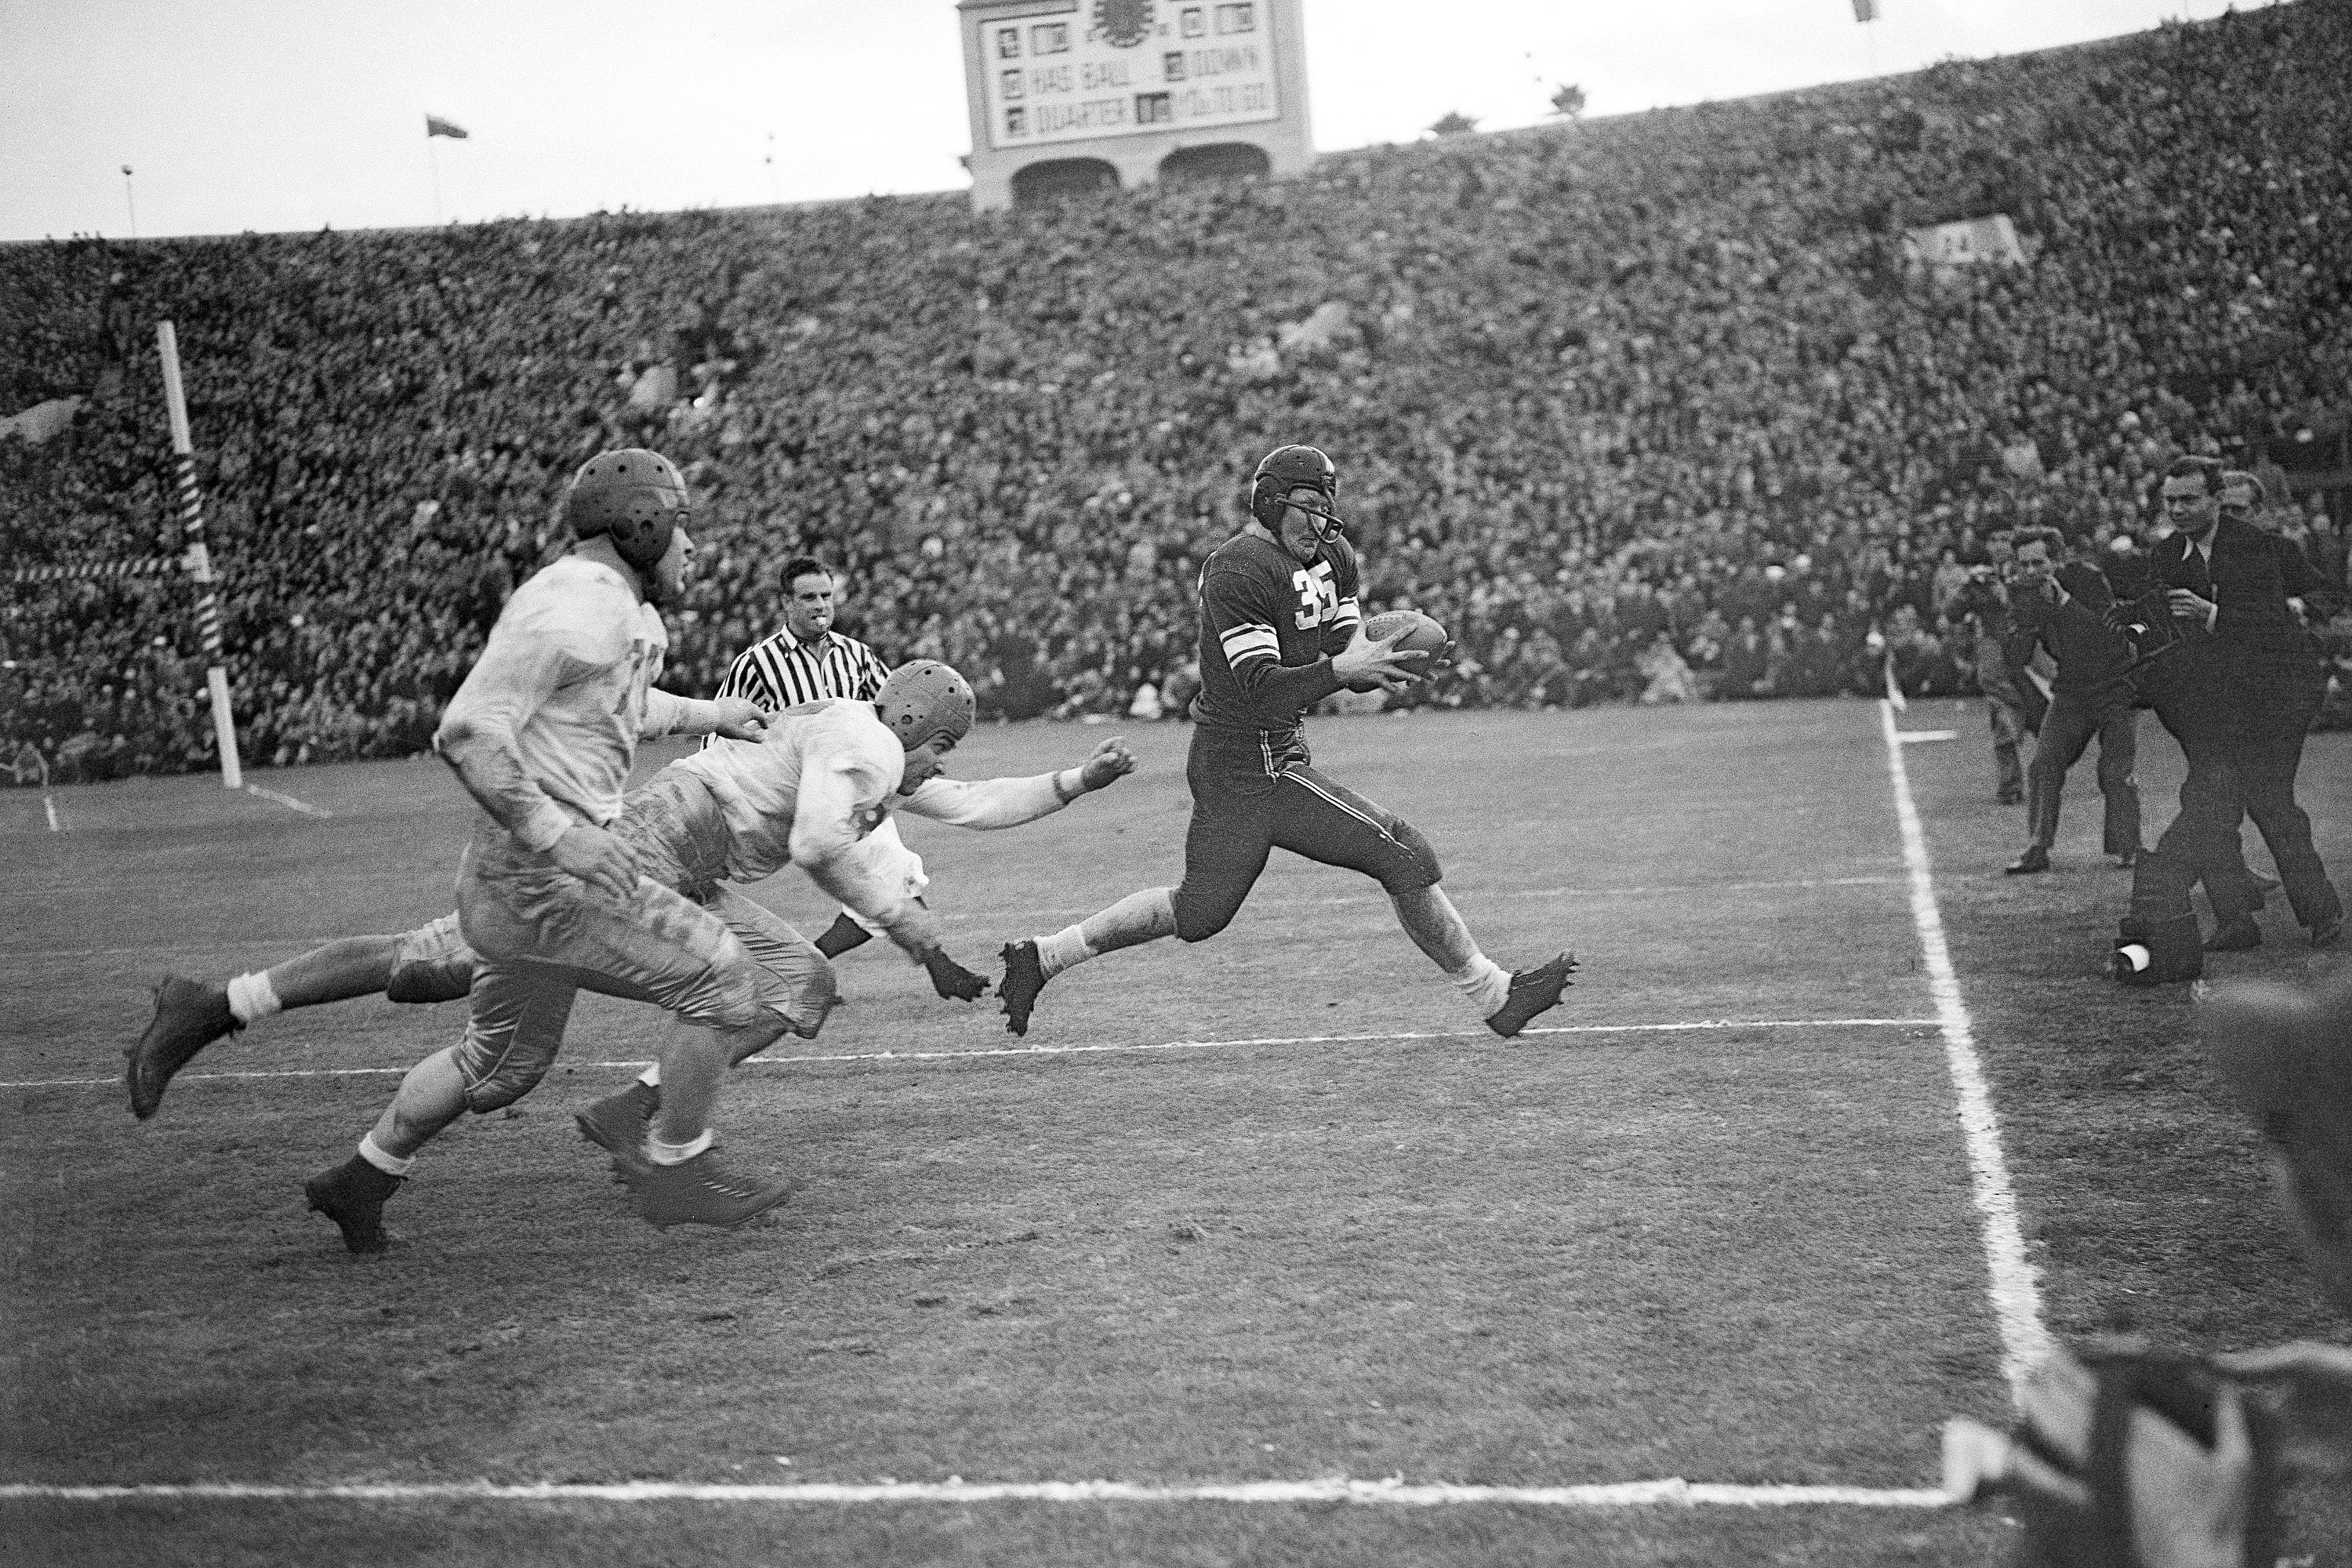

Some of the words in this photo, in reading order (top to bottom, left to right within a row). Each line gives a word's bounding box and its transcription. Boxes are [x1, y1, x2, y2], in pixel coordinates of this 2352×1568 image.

[1080, 58, 1131, 90] BALL
[1036, 97, 1125, 134] QUARTER
[1292, 559, 1339, 630] 35
